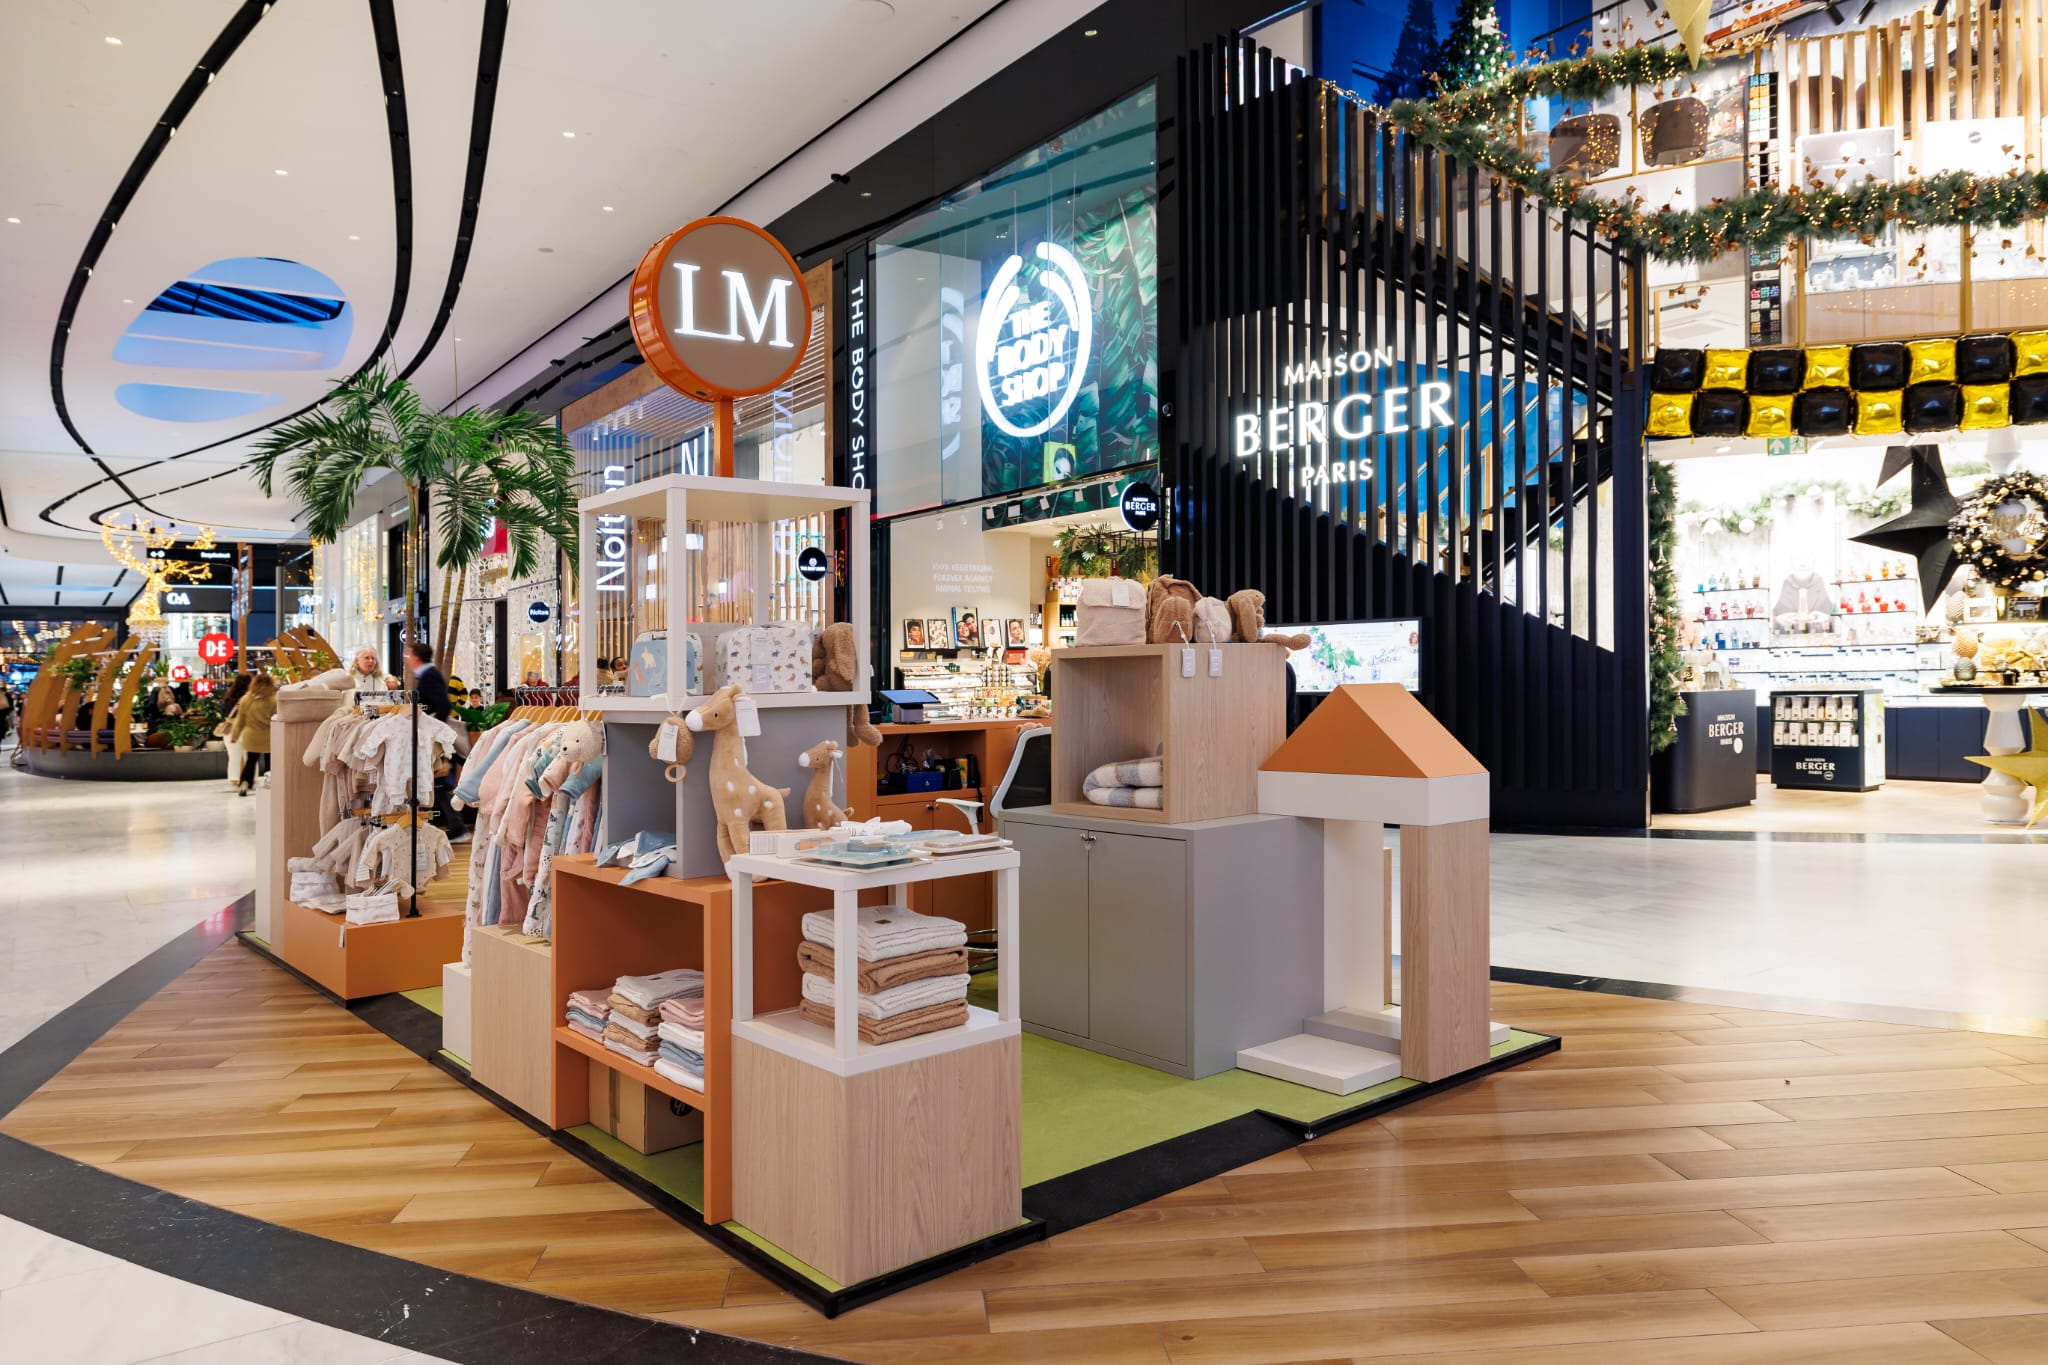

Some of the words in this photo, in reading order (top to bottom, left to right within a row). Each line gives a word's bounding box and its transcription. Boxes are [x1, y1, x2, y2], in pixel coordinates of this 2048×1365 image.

[673, 262, 794, 348] LM
[851, 279, 864, 338] THE
[1009, 301, 1051, 338] THE
[997, 324, 1068, 376] BODY
[1283, 345, 1393, 386] MAISON
[851, 347, 864, 427] BODY
[1001, 362, 1065, 406] SHOP
[1235, 381, 1455, 457] BERGER
[852, 440, 864, 490] SHO
[1300, 457, 1373, 487] PARIS
[595, 464, 626, 592] Noltn
[1125, 500, 1156, 512] BERGER
[1708, 721, 1744, 738] BERGER
[1795, 762, 1836, 771] BERGER
